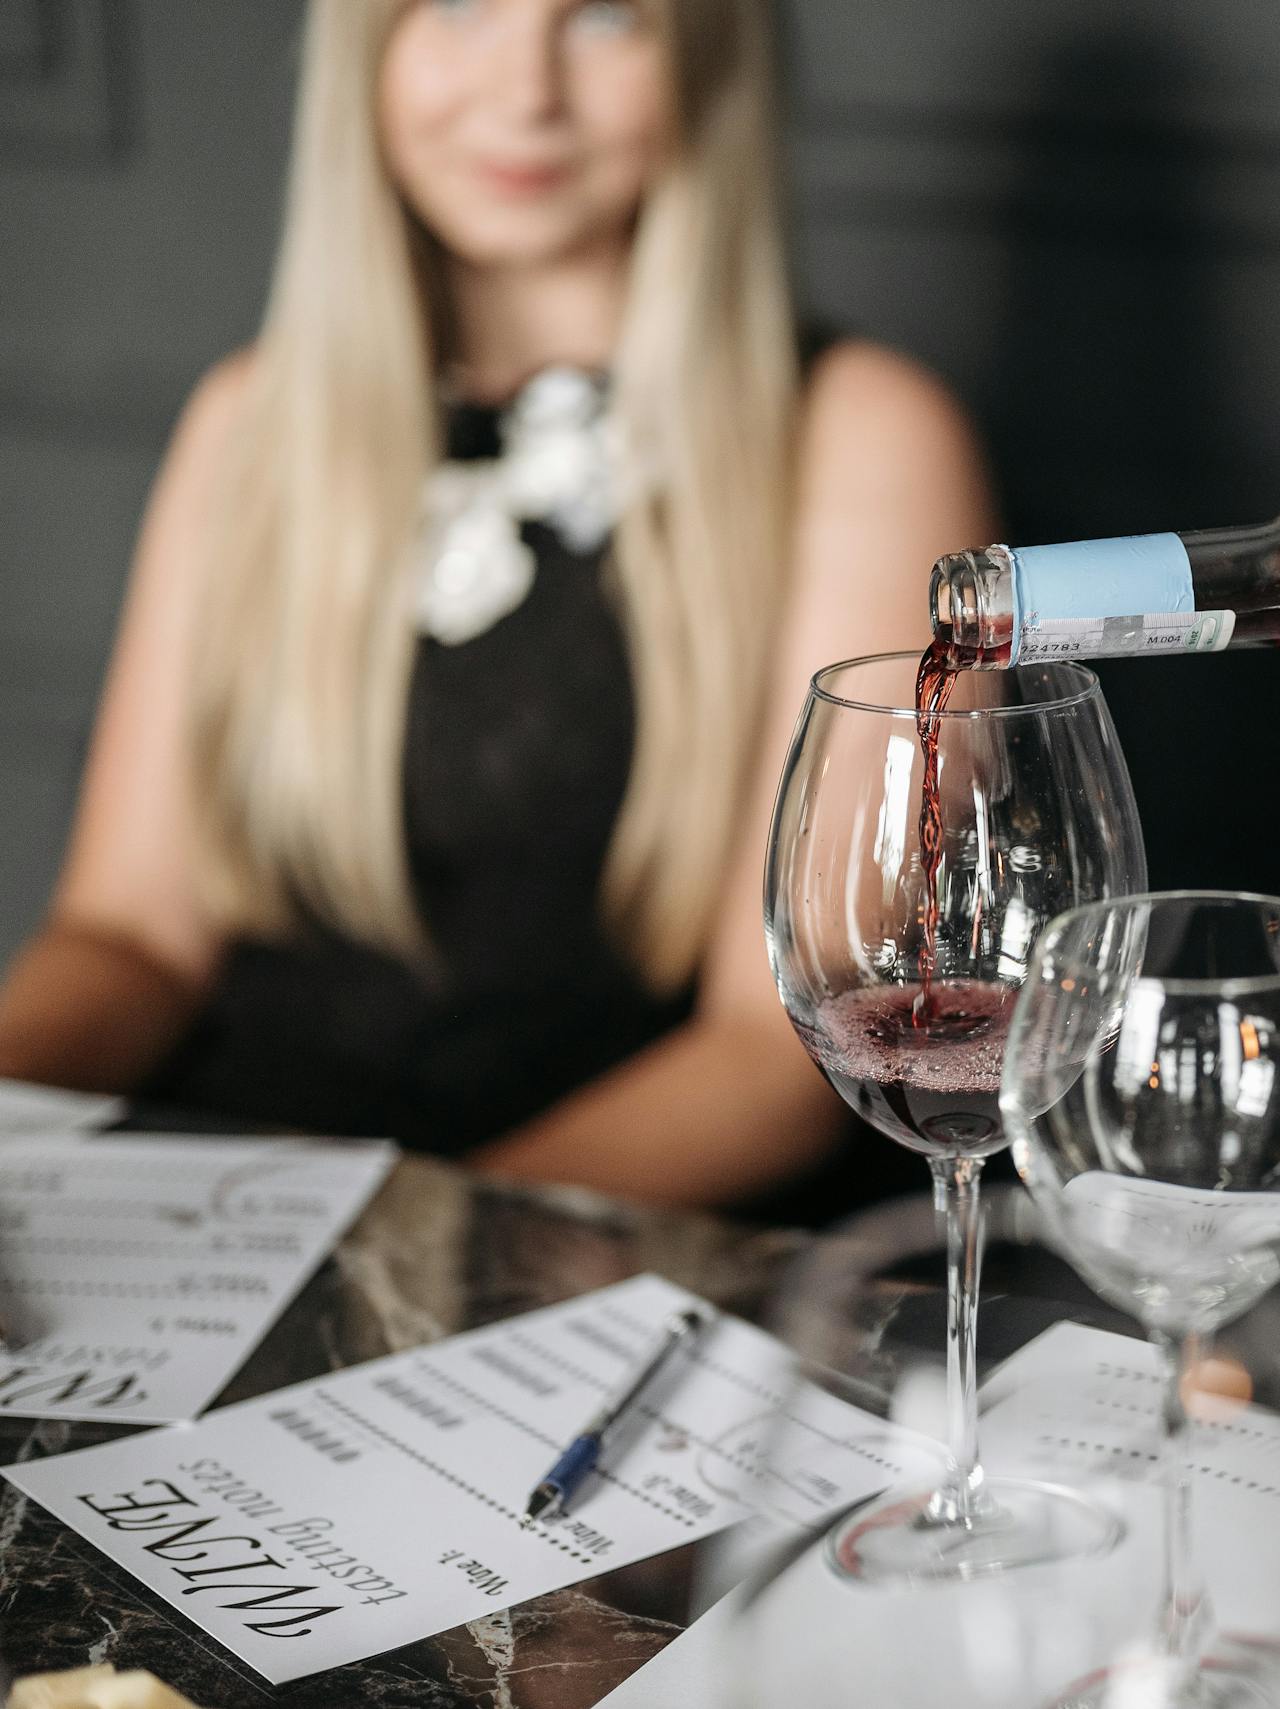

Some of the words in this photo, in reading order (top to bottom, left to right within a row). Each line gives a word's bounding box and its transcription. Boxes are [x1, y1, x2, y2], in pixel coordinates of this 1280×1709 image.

[178, 1457, 284, 1518] notes
[76, 1478, 345, 1638] WINE
[267, 1517, 408, 1606] tasting
[457, 1559, 510, 1597] Wine
